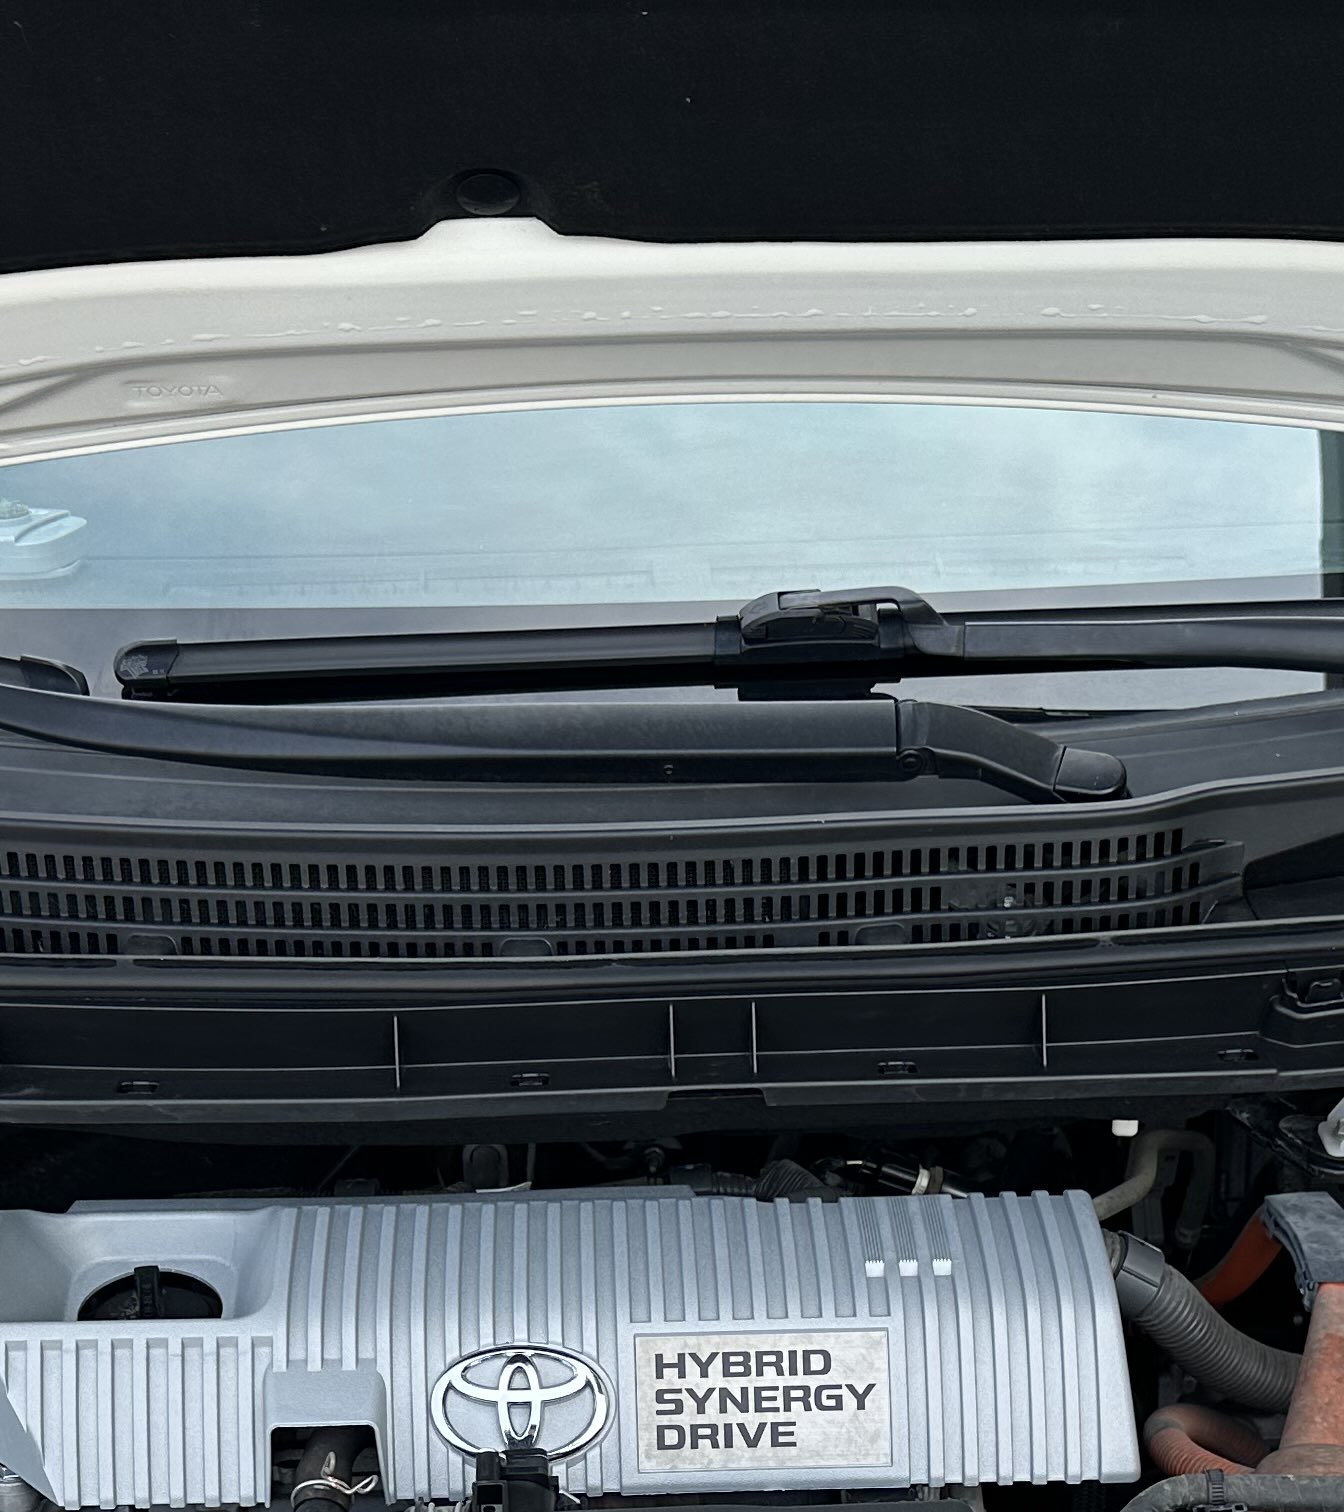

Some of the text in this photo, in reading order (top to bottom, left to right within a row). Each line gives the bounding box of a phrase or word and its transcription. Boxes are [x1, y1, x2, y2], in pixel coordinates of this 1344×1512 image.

[132, 385, 224, 399] TOYOTA
[655, 1349, 832, 1379] HYBRID
[655, 1383, 877, 1415] SYNERGY
[656, 1421, 797, 1450] DRIVE
